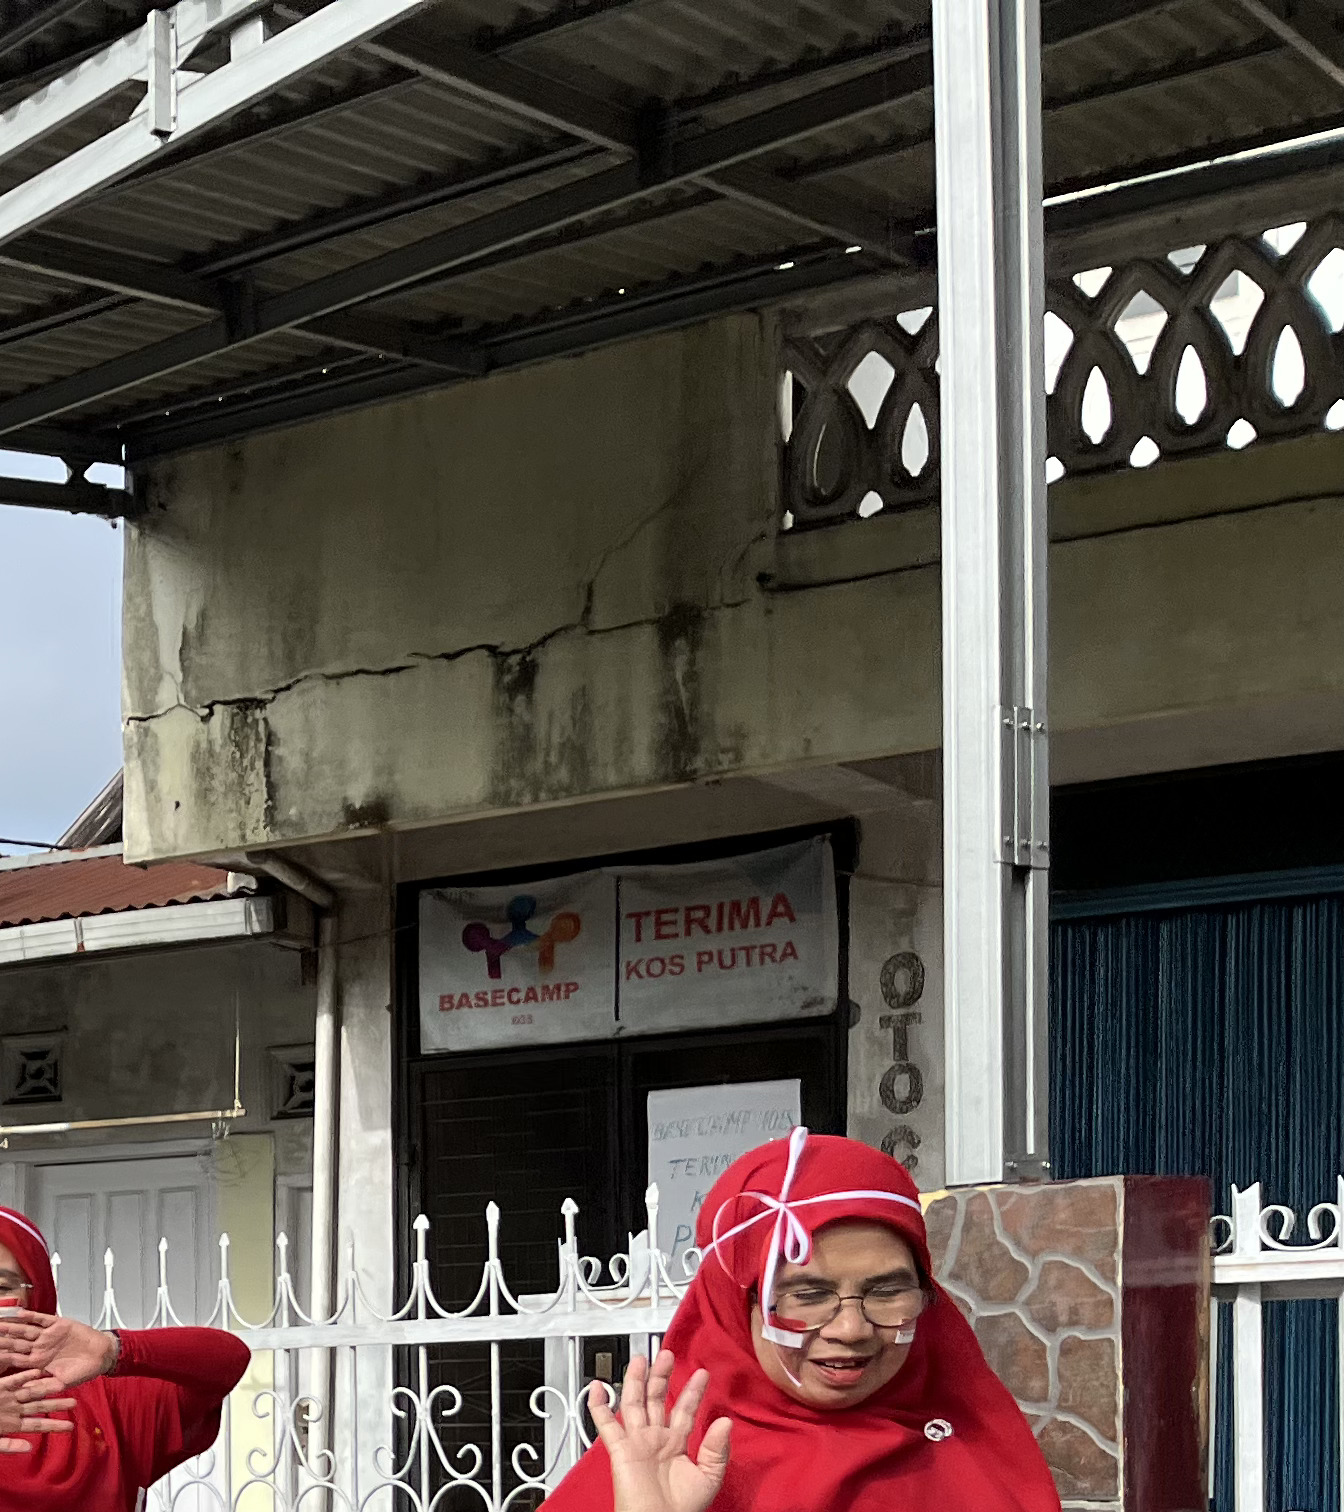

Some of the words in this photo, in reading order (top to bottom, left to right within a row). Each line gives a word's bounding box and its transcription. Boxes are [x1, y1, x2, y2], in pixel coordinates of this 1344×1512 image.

[625, 892, 797, 943] TERIMA
[624, 953, 686, 981] KOS
[696, 940, 799, 974] PUTRA
[438, 982, 581, 1012] BASECAMP
